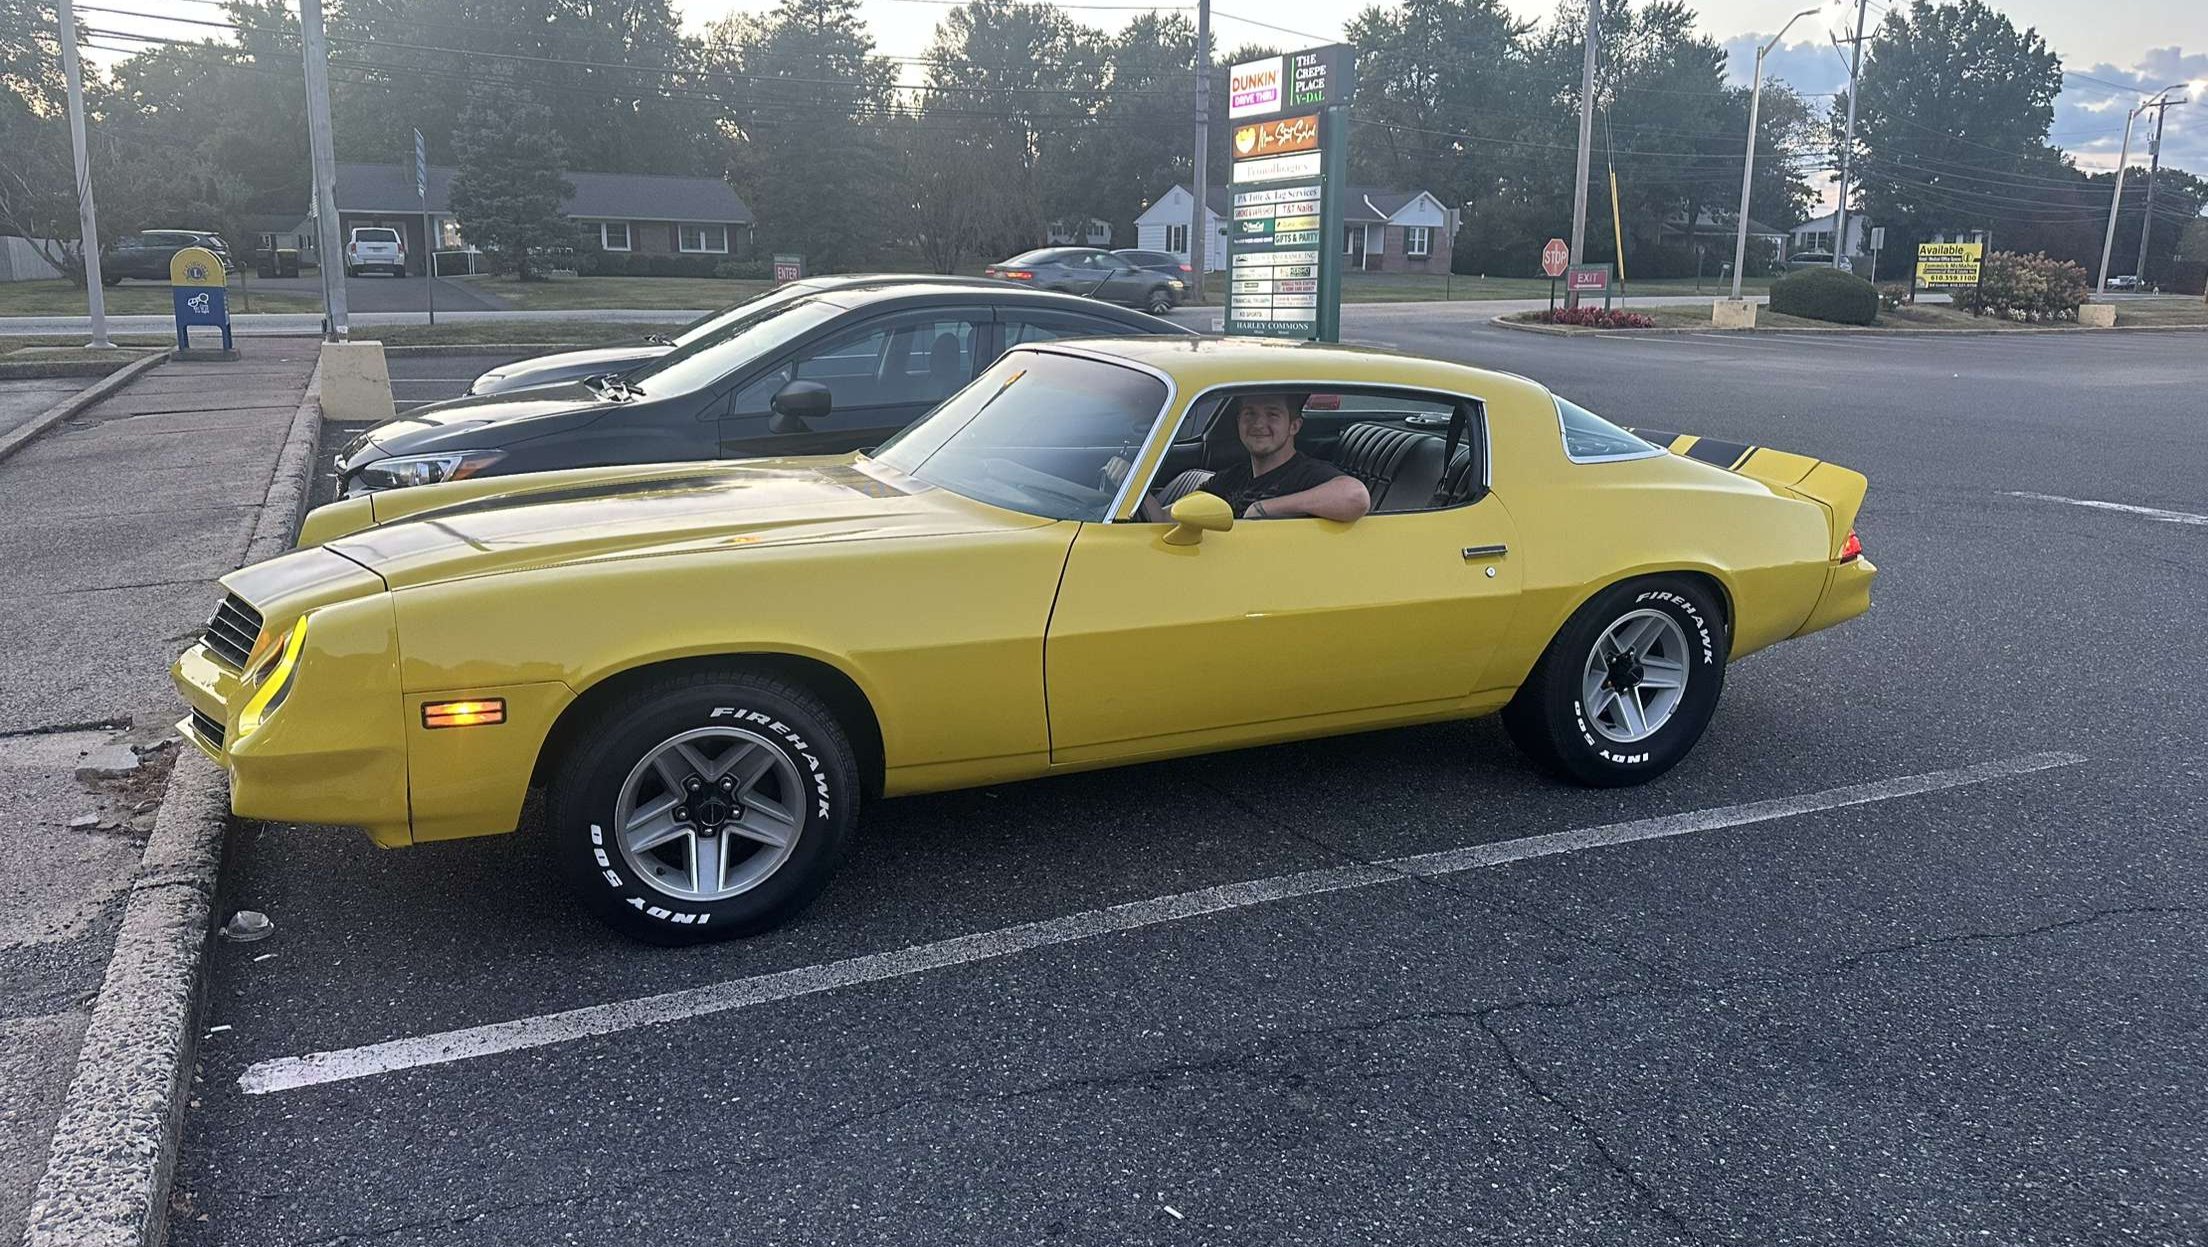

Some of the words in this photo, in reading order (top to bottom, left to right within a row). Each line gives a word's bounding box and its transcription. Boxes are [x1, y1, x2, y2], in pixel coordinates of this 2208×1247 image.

[1295, 54, 1317, 67] THE
[1295, 65, 1327, 80] CREPE
[1295, 78, 1325, 92] PLACE
[1234, 93, 1255, 107] DRIVE
[1256, 90, 1275, 104] THRU
[1295, 91, 1325, 105] V-DAL
[1288, 188, 1317, 198] Services
[1296, 203, 1314, 213] Nails
[1275, 234, 1292, 243] GIFTS
[1292, 233, 1298, 242] &
[1298, 232, 1319, 242] PARTY
[1544, 250, 1567, 264] STOP
[1919, 245, 1964, 255] Available
[777, 266, 798, 280] ENTER
[1577, 272, 1599, 283] EXIT
[1236, 321, 1266, 330] HARLEY
[1267, 322, 1309, 331] COMMONS
[1635, 591, 1713, 665] FIREHAWK
[1574, 700, 1596, 747] 500
[709, 706, 830, 820] FIREHAWK
[1599, 749, 1649, 764] INDY
[590, 823, 623, 888] 500
[626, 896, 711, 925] INDY
